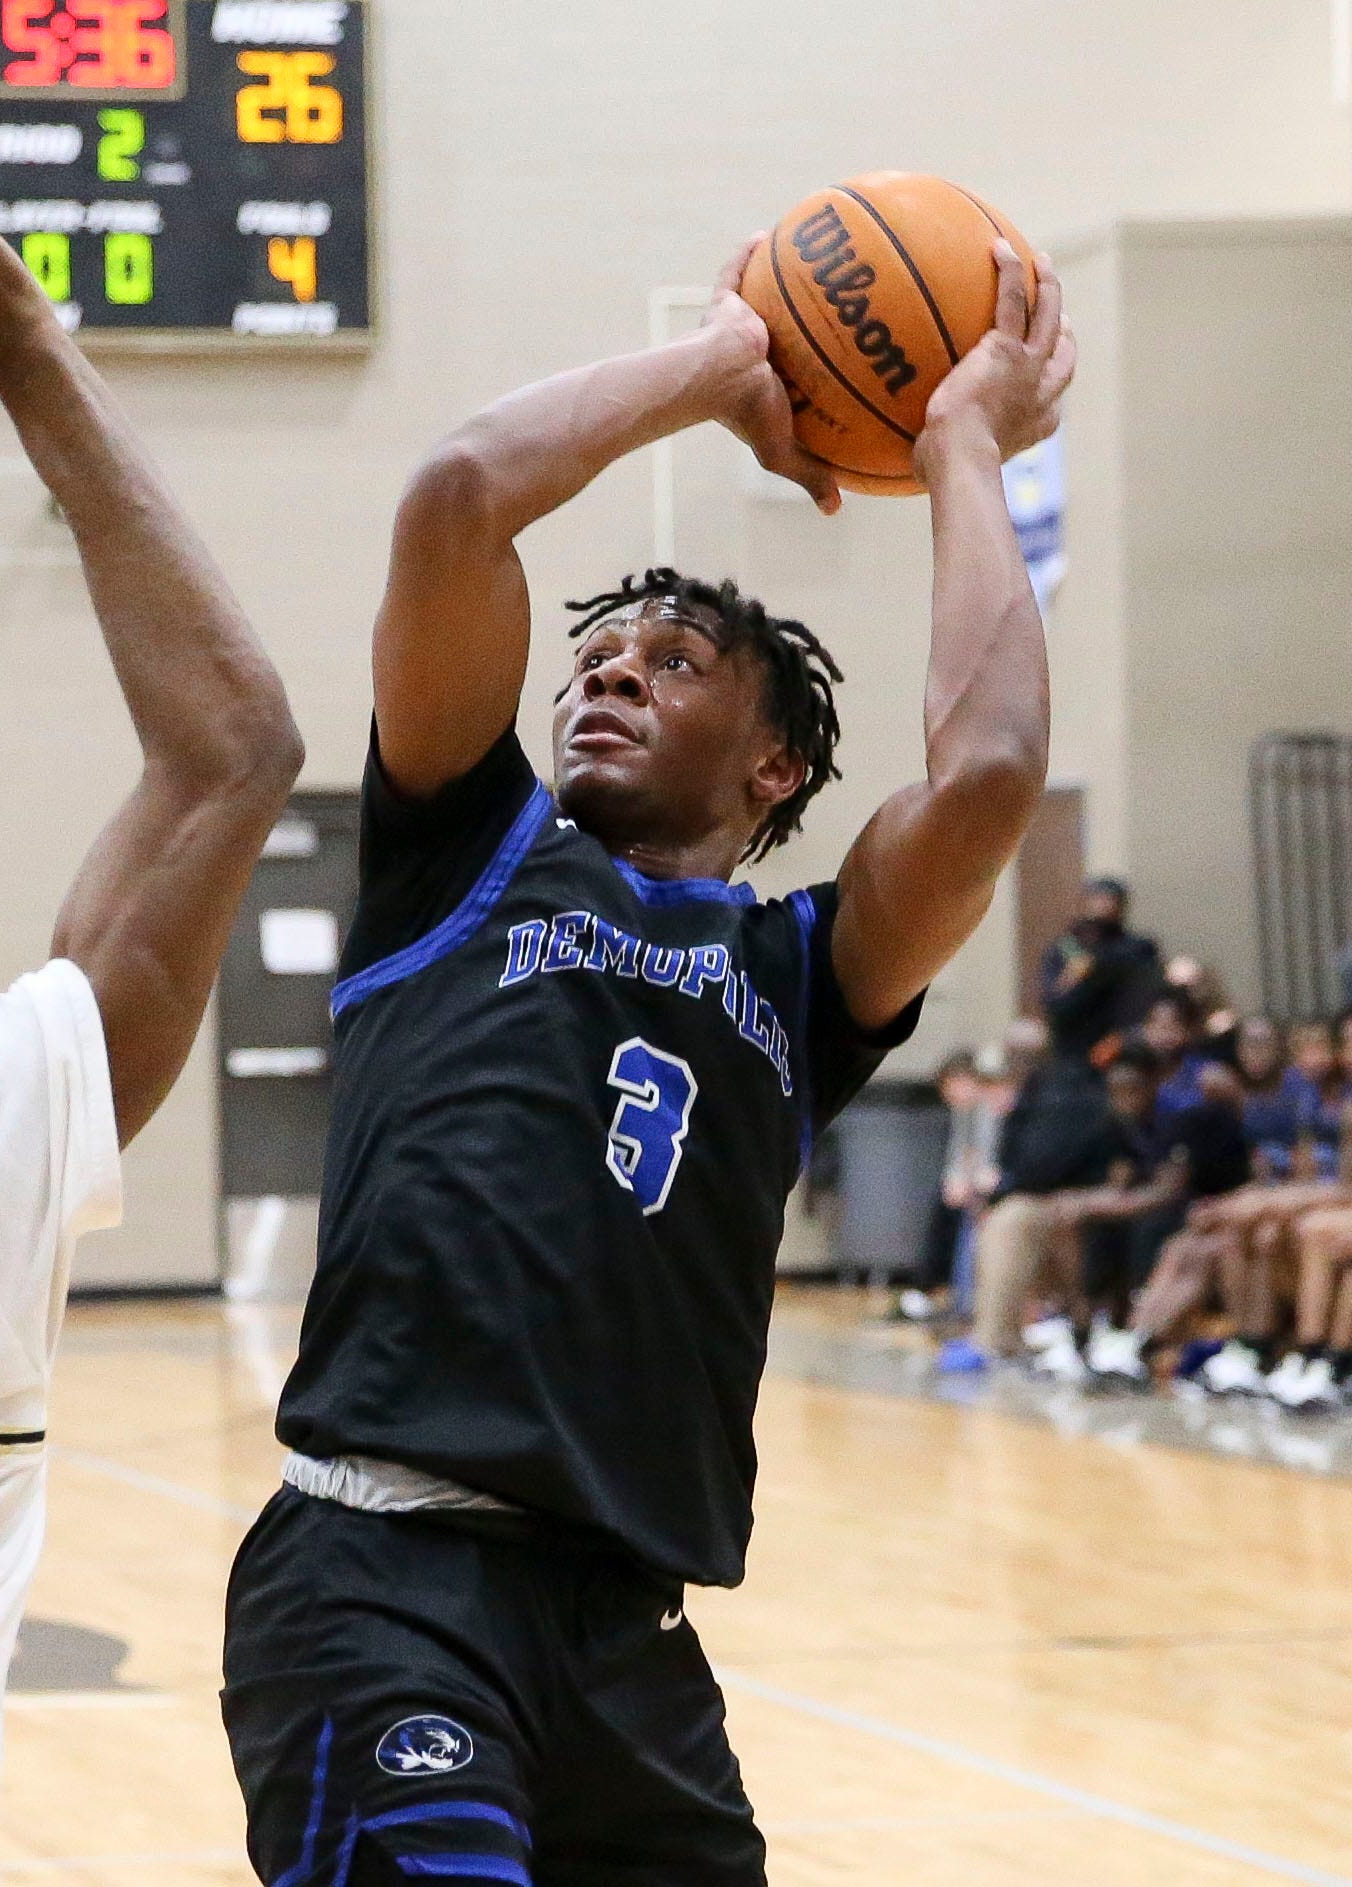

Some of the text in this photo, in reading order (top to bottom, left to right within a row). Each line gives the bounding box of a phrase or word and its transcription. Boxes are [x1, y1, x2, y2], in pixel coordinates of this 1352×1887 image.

[2, 0, 176, 88] 5:36
[236, 51, 344, 143] 26
[97, 109, 146, 182] 2
[22, 233, 72, 304] 0
[104, 233, 154, 305] 0
[267, 236, 317, 304] 4
[791, 202, 918, 397] Wilson
[606, 1035, 700, 1217] 3
